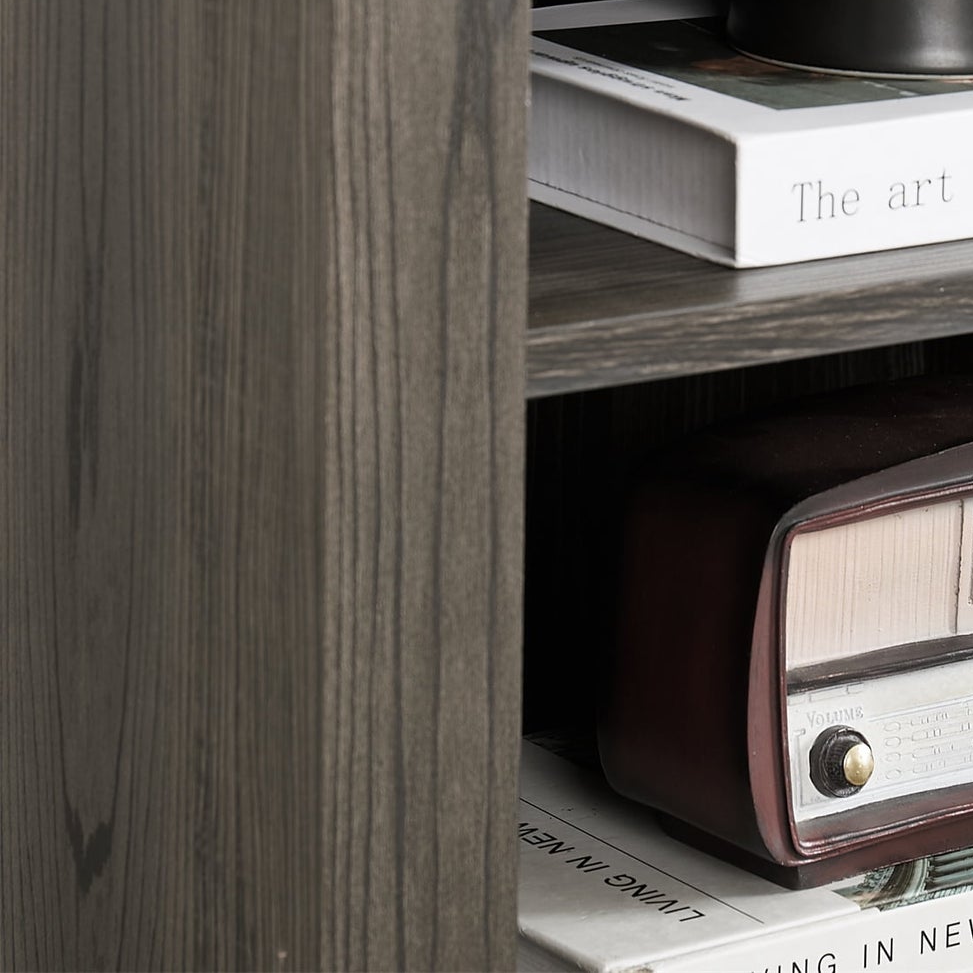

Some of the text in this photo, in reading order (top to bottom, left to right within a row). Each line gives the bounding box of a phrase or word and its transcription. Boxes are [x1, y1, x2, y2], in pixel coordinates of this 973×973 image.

[791, 178, 861, 223] The
[887, 167, 954, 211] art
[565, 855, 611, 874] IN
[604, 873, 706, 922] LIVING
[862, 936, 895, 969] IN
